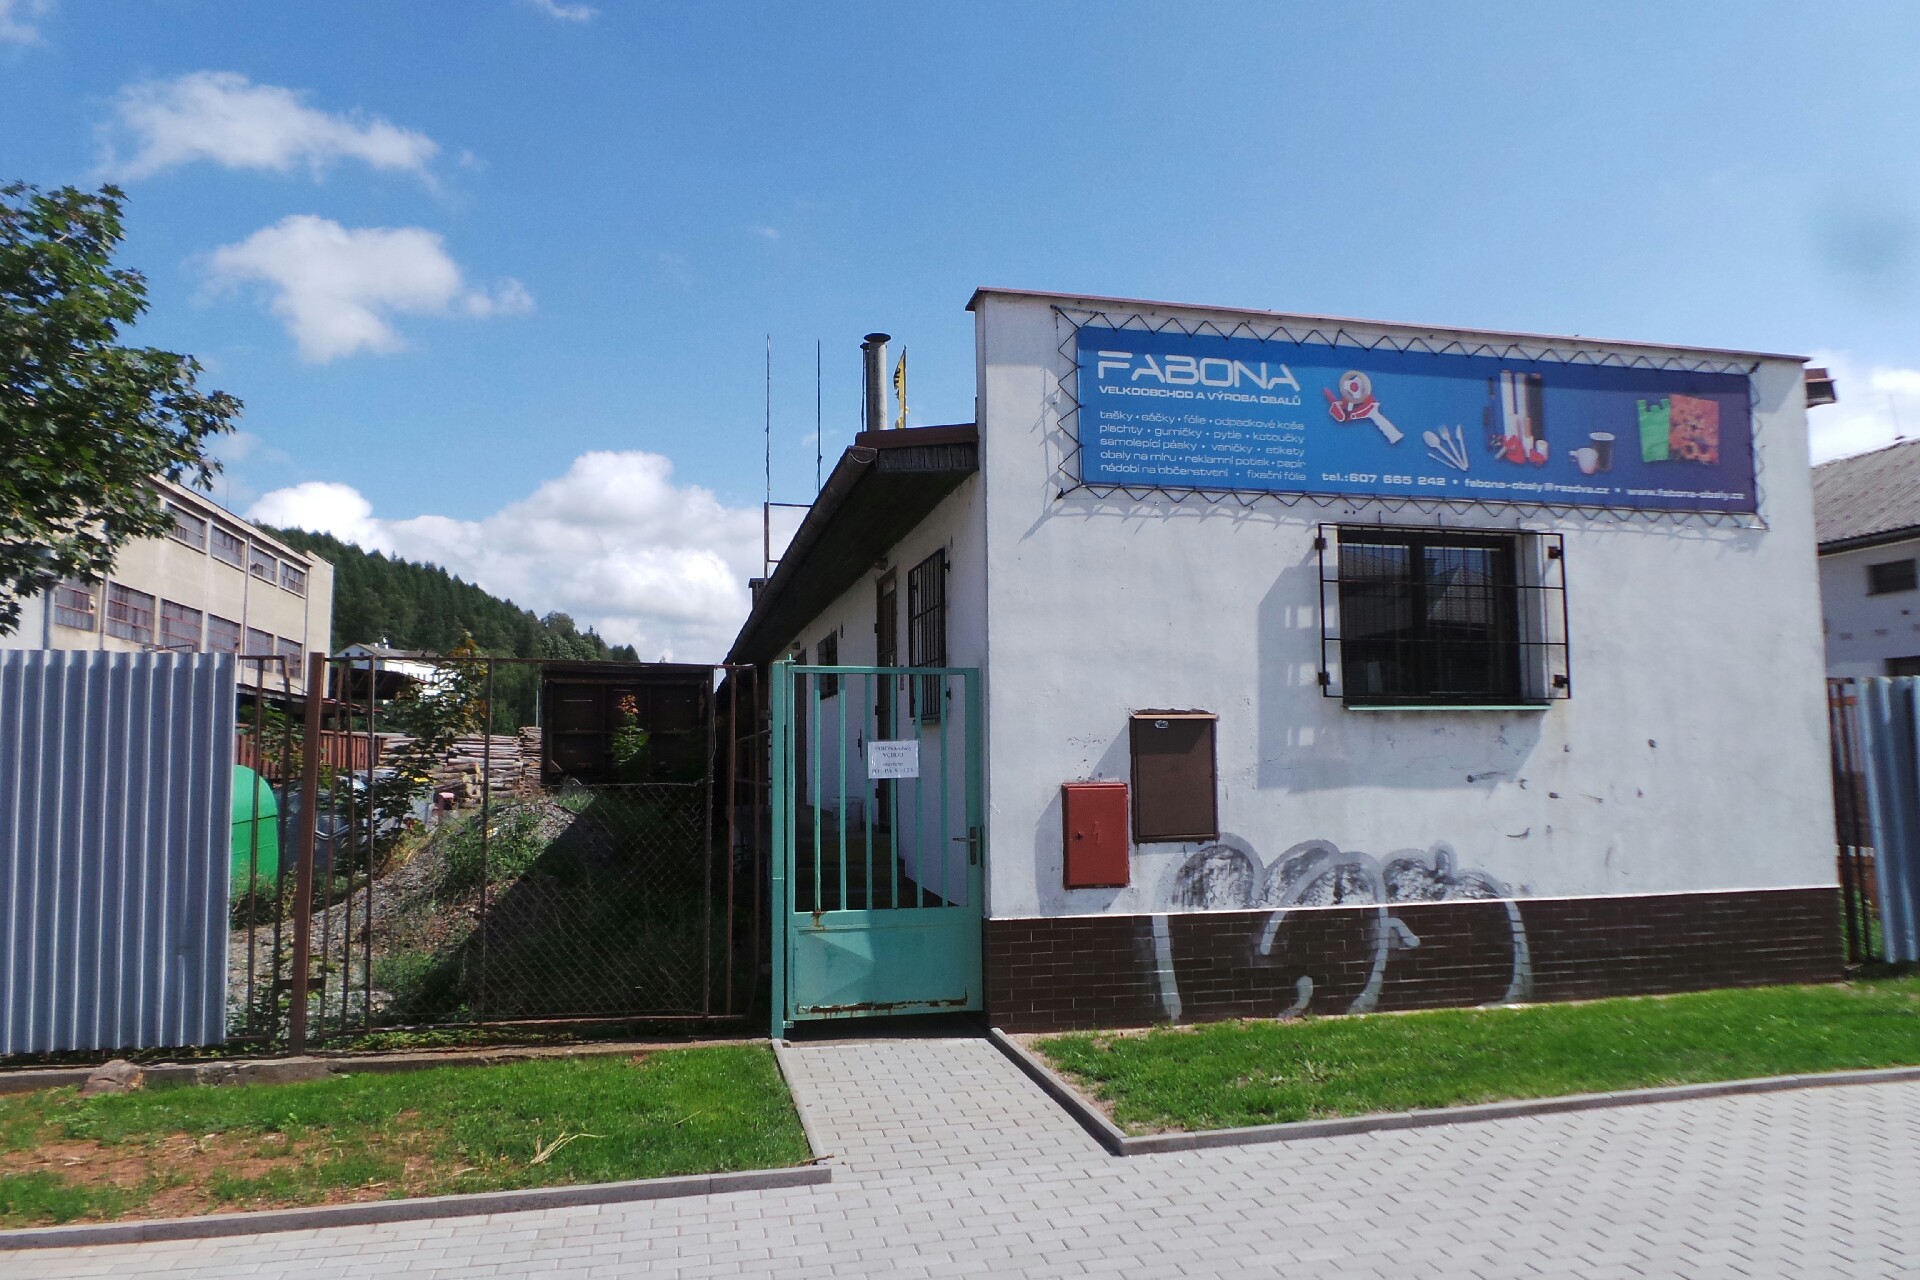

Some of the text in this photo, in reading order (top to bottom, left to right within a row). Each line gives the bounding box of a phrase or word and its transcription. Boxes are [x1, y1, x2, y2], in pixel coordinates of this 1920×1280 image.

[1097, 350, 1301, 392] FABONA
[1099, 385, 1301, 406] VELKOOBCHOD A VÝROBA OBALŮ
[1099, 411, 1305, 431] tašky sáčky fólie odpadkové koše
[1099, 424, 1144, 436] plachty
[1154, 427, 1202, 439] gumičky
[1213, 430, 1242, 440] pytle
[1162, 440, 1197, 451] pásky
[1211, 443, 1253, 454] vaničky
[1265, 446, 1305, 457] etikety
[1100, 450, 1132, 461] obaly
[1133, 453, 1148, 461] na
[1184, 454, 1234, 465] reklamní
[1235, 457, 1270, 467] potisk
[1100, 463, 1140, 473] nádobí
[1141, 467, 1156, 475] na
[1246, 469, 1282, 480] fixační
[1283, 471, 1307, 481] fólie
[1382, 474, 1412, 485] 665
[1417, 476, 1446, 486] 242
